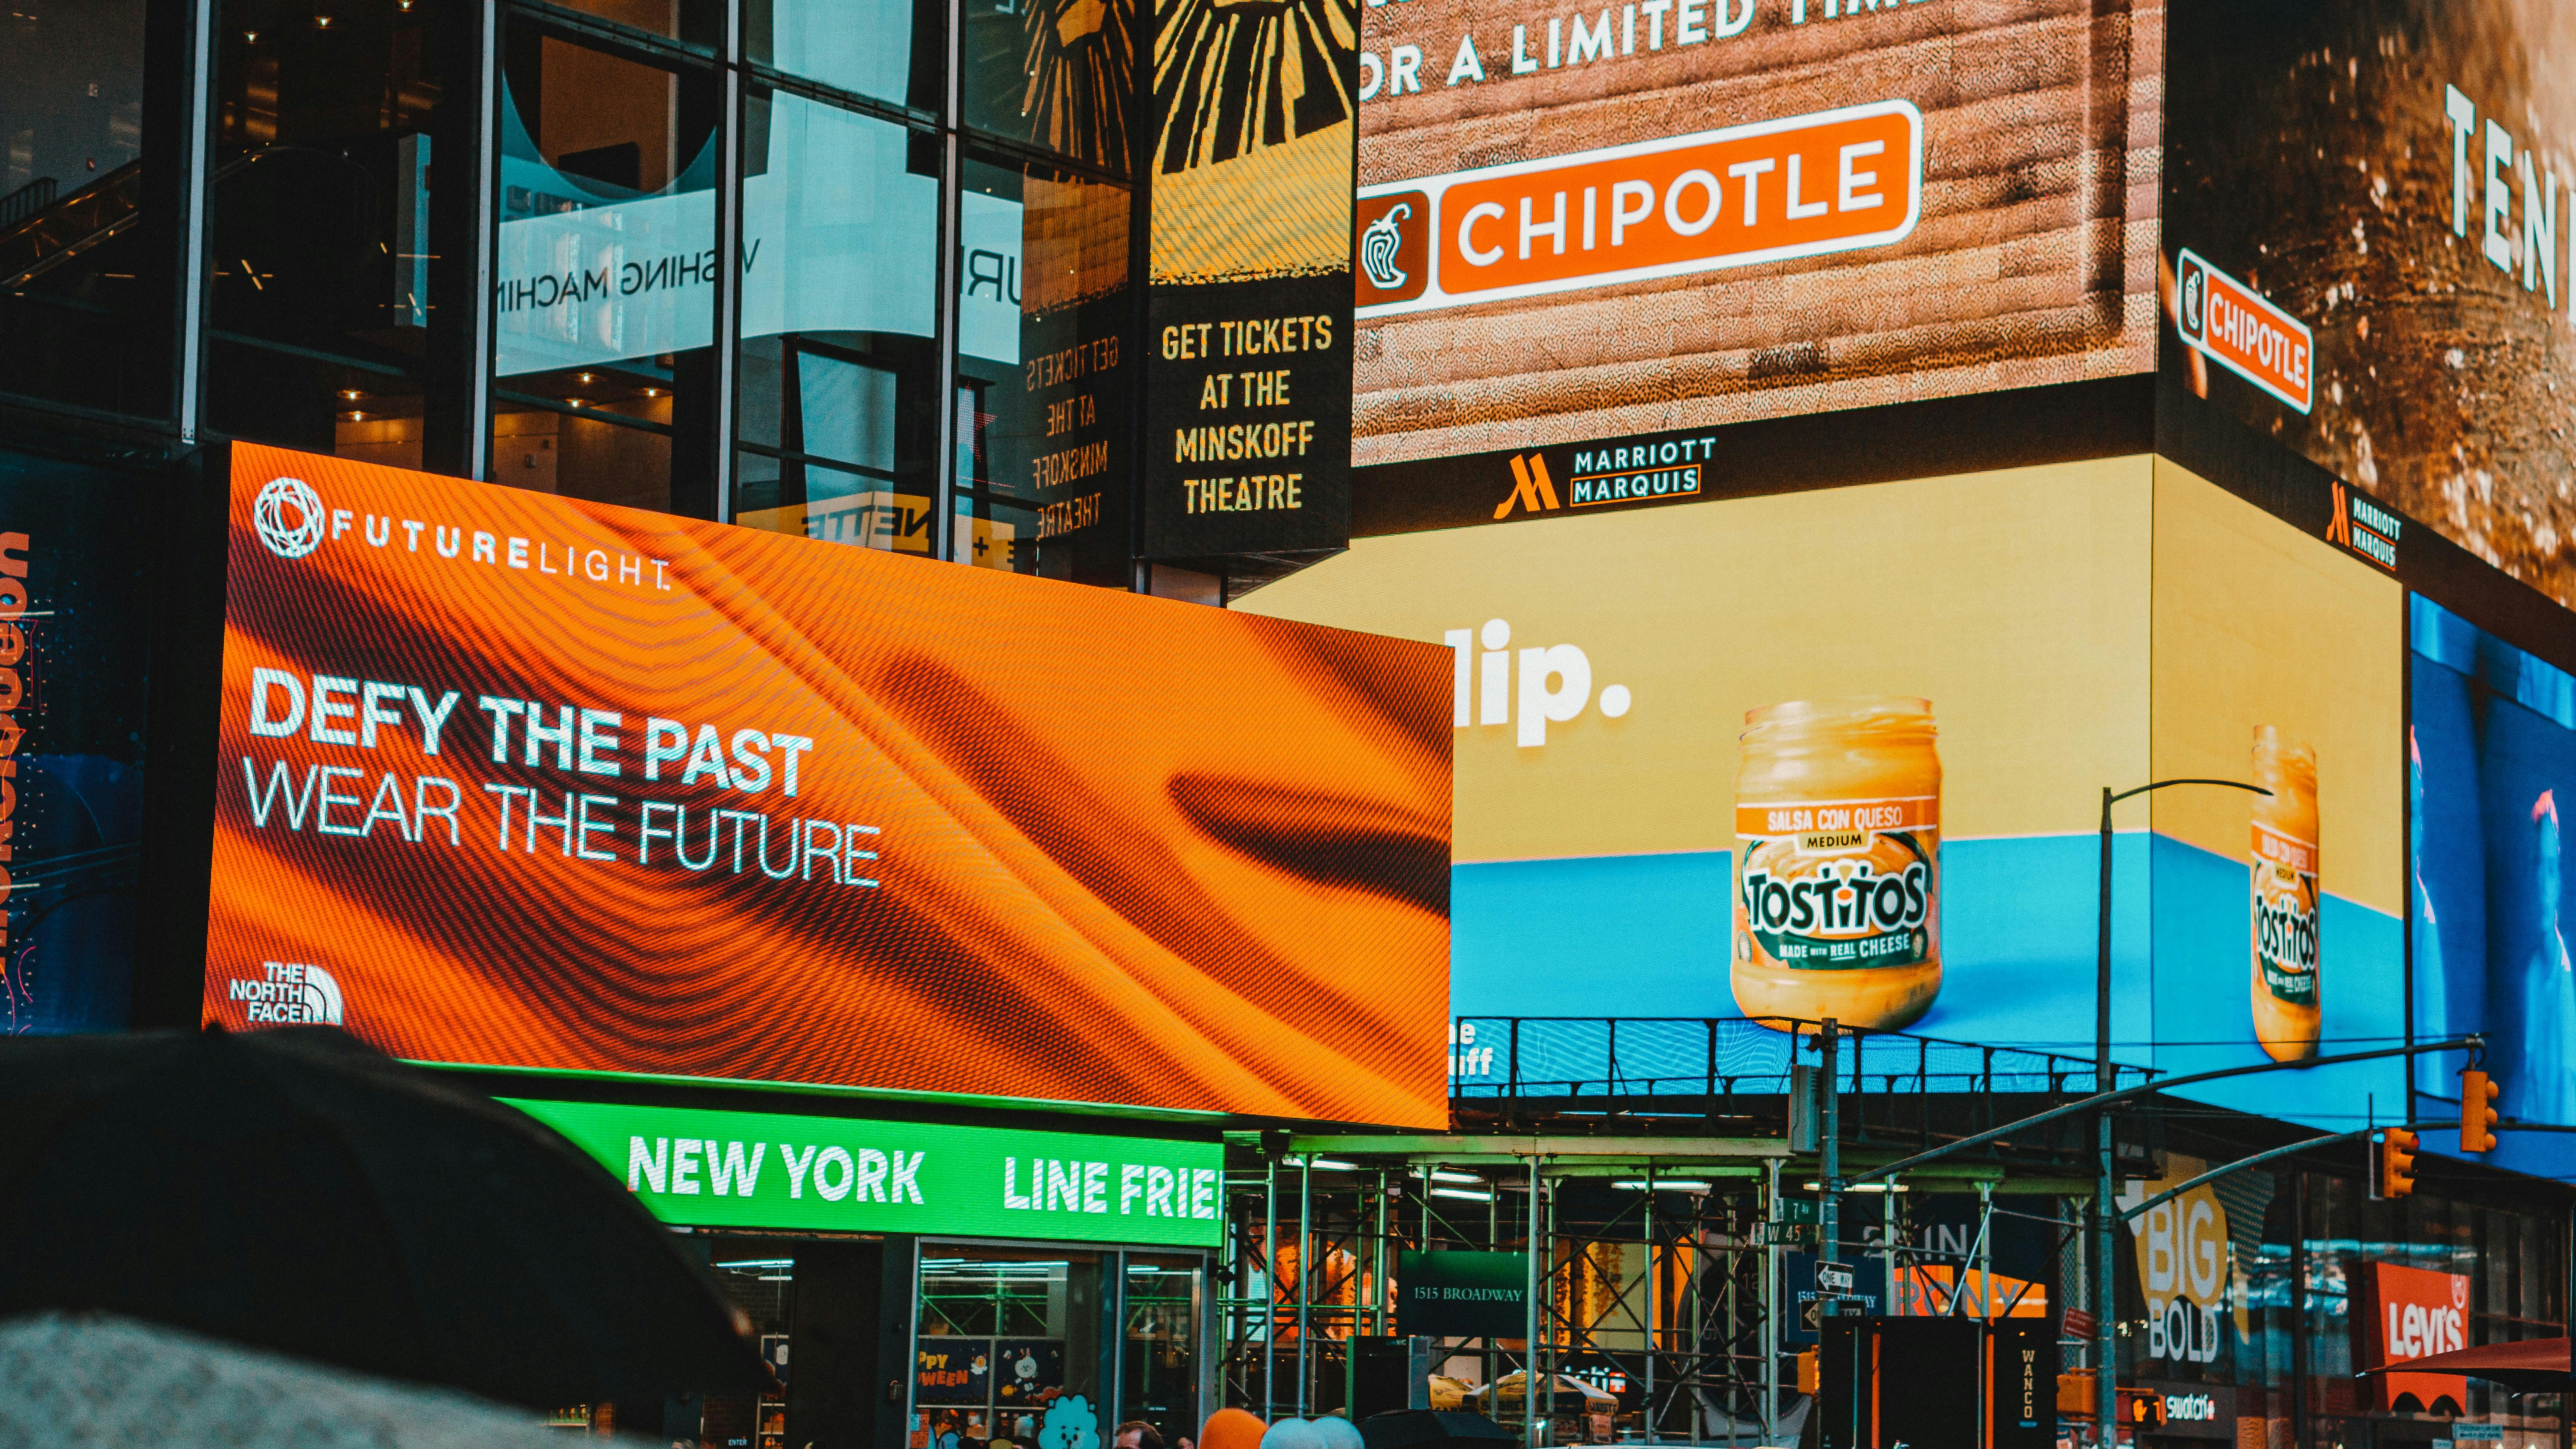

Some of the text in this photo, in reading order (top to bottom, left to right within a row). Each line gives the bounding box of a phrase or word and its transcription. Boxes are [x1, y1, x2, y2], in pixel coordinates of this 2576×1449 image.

[1447, 34, 1485, 86] A
[1512, 0, 1754, 75] LIMITED
[1458, 139, 1886, 267] CHIPOTLE
[2445, 84, 2576, 327] TEN
[1162, 314, 1333, 360] GET TICKETS
[2209, 291, 2306, 390] CHIPOTLE
[1200, 369, 1291, 410] AT THE
[1175, 420, 1315, 464] MINSKOFF
[1574, 437, 1716, 473] MARRIOTT
[1184, 473, 1303, 514] THEATRE
[1574, 469, 1697, 503] MARQUIS
[2353, 497, 2401, 541] MARRIOTT
[2353, 527, 2396, 567] MARQUIS
[249, 667, 813, 797] DEFY THE PAST
[243, 756, 880, 888] WEAR THE FUTURE
[1768, 806, 1902, 832] SALSA CON QUESO
[1807, 834, 1862, 848] MEDIUM
[2276, 867, 2294, 880] MEDIUM
[1780, 945, 1807, 958] MADE
[1830, 943, 1856, 956] REAL
[1859, 934, 1909, 957] CHEESE
[230, 978, 304, 1003] NORTH
[263, 961, 305, 983] THE
[248, 1001, 303, 1023] FACE
[627, 1136, 925, 1205] NEW YORK
[1004, 1157, 1224, 1220] LINE FRIE
[1768, 1226, 1779, 1241] W
[1786, 1225, 1801, 1241] 45
[2148, 1193, 2217, 1299] BIG
[1415, 1288, 1523, 1302] 1515 BROADWAY
[2149, 1297, 2218, 1364] BOLD
[2022, 1350, 2035, 1418] WANCO
